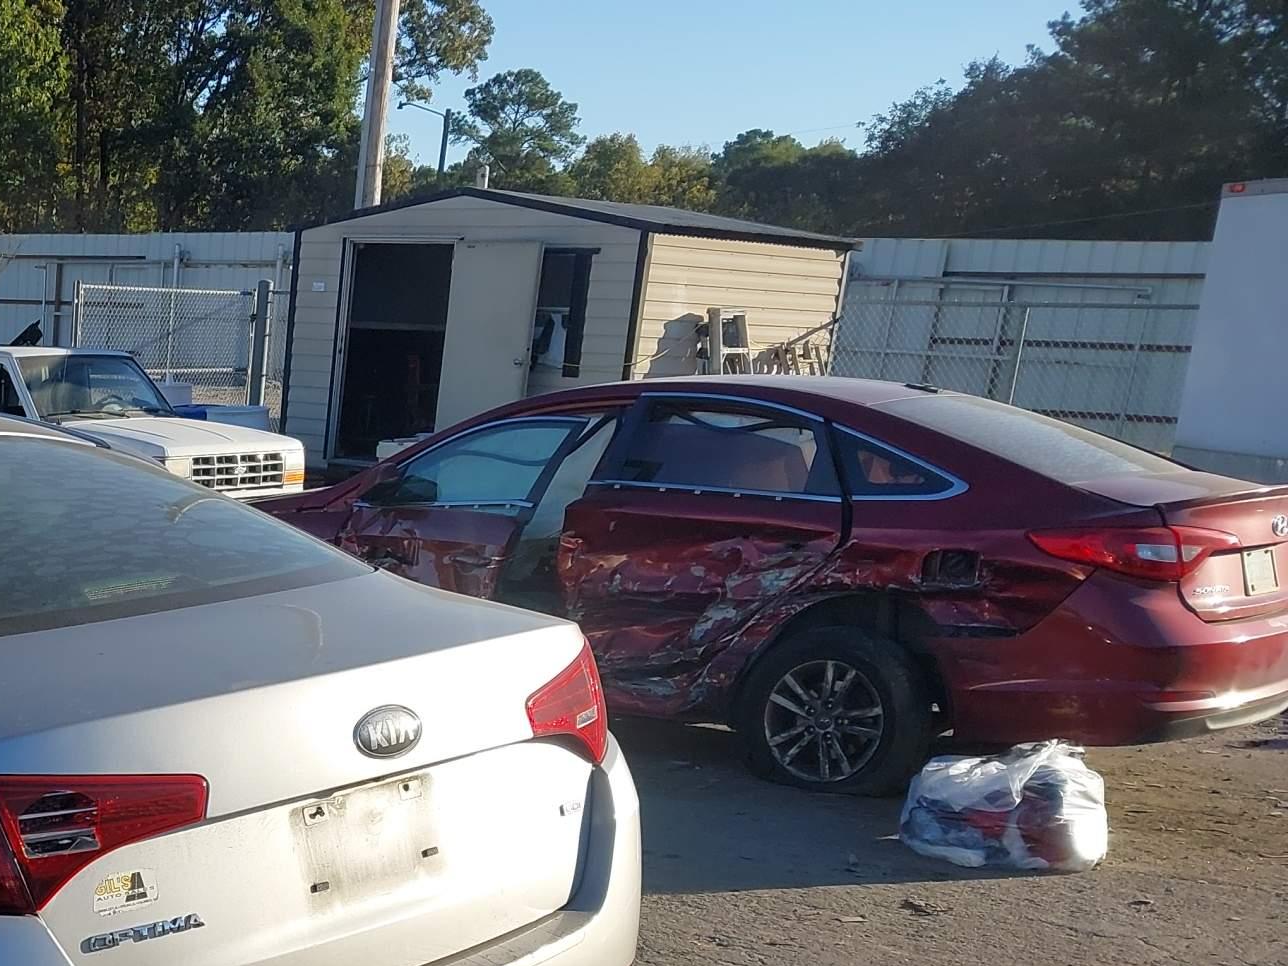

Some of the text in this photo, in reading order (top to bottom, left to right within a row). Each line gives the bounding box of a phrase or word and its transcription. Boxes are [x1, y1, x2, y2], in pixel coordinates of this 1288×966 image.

[367, 718, 416, 751] KIA
[95, 875, 131, 896] GIL'S
[96, 892, 122, 902] AUTO
[80, 913, 205, 954] OPTIMA
